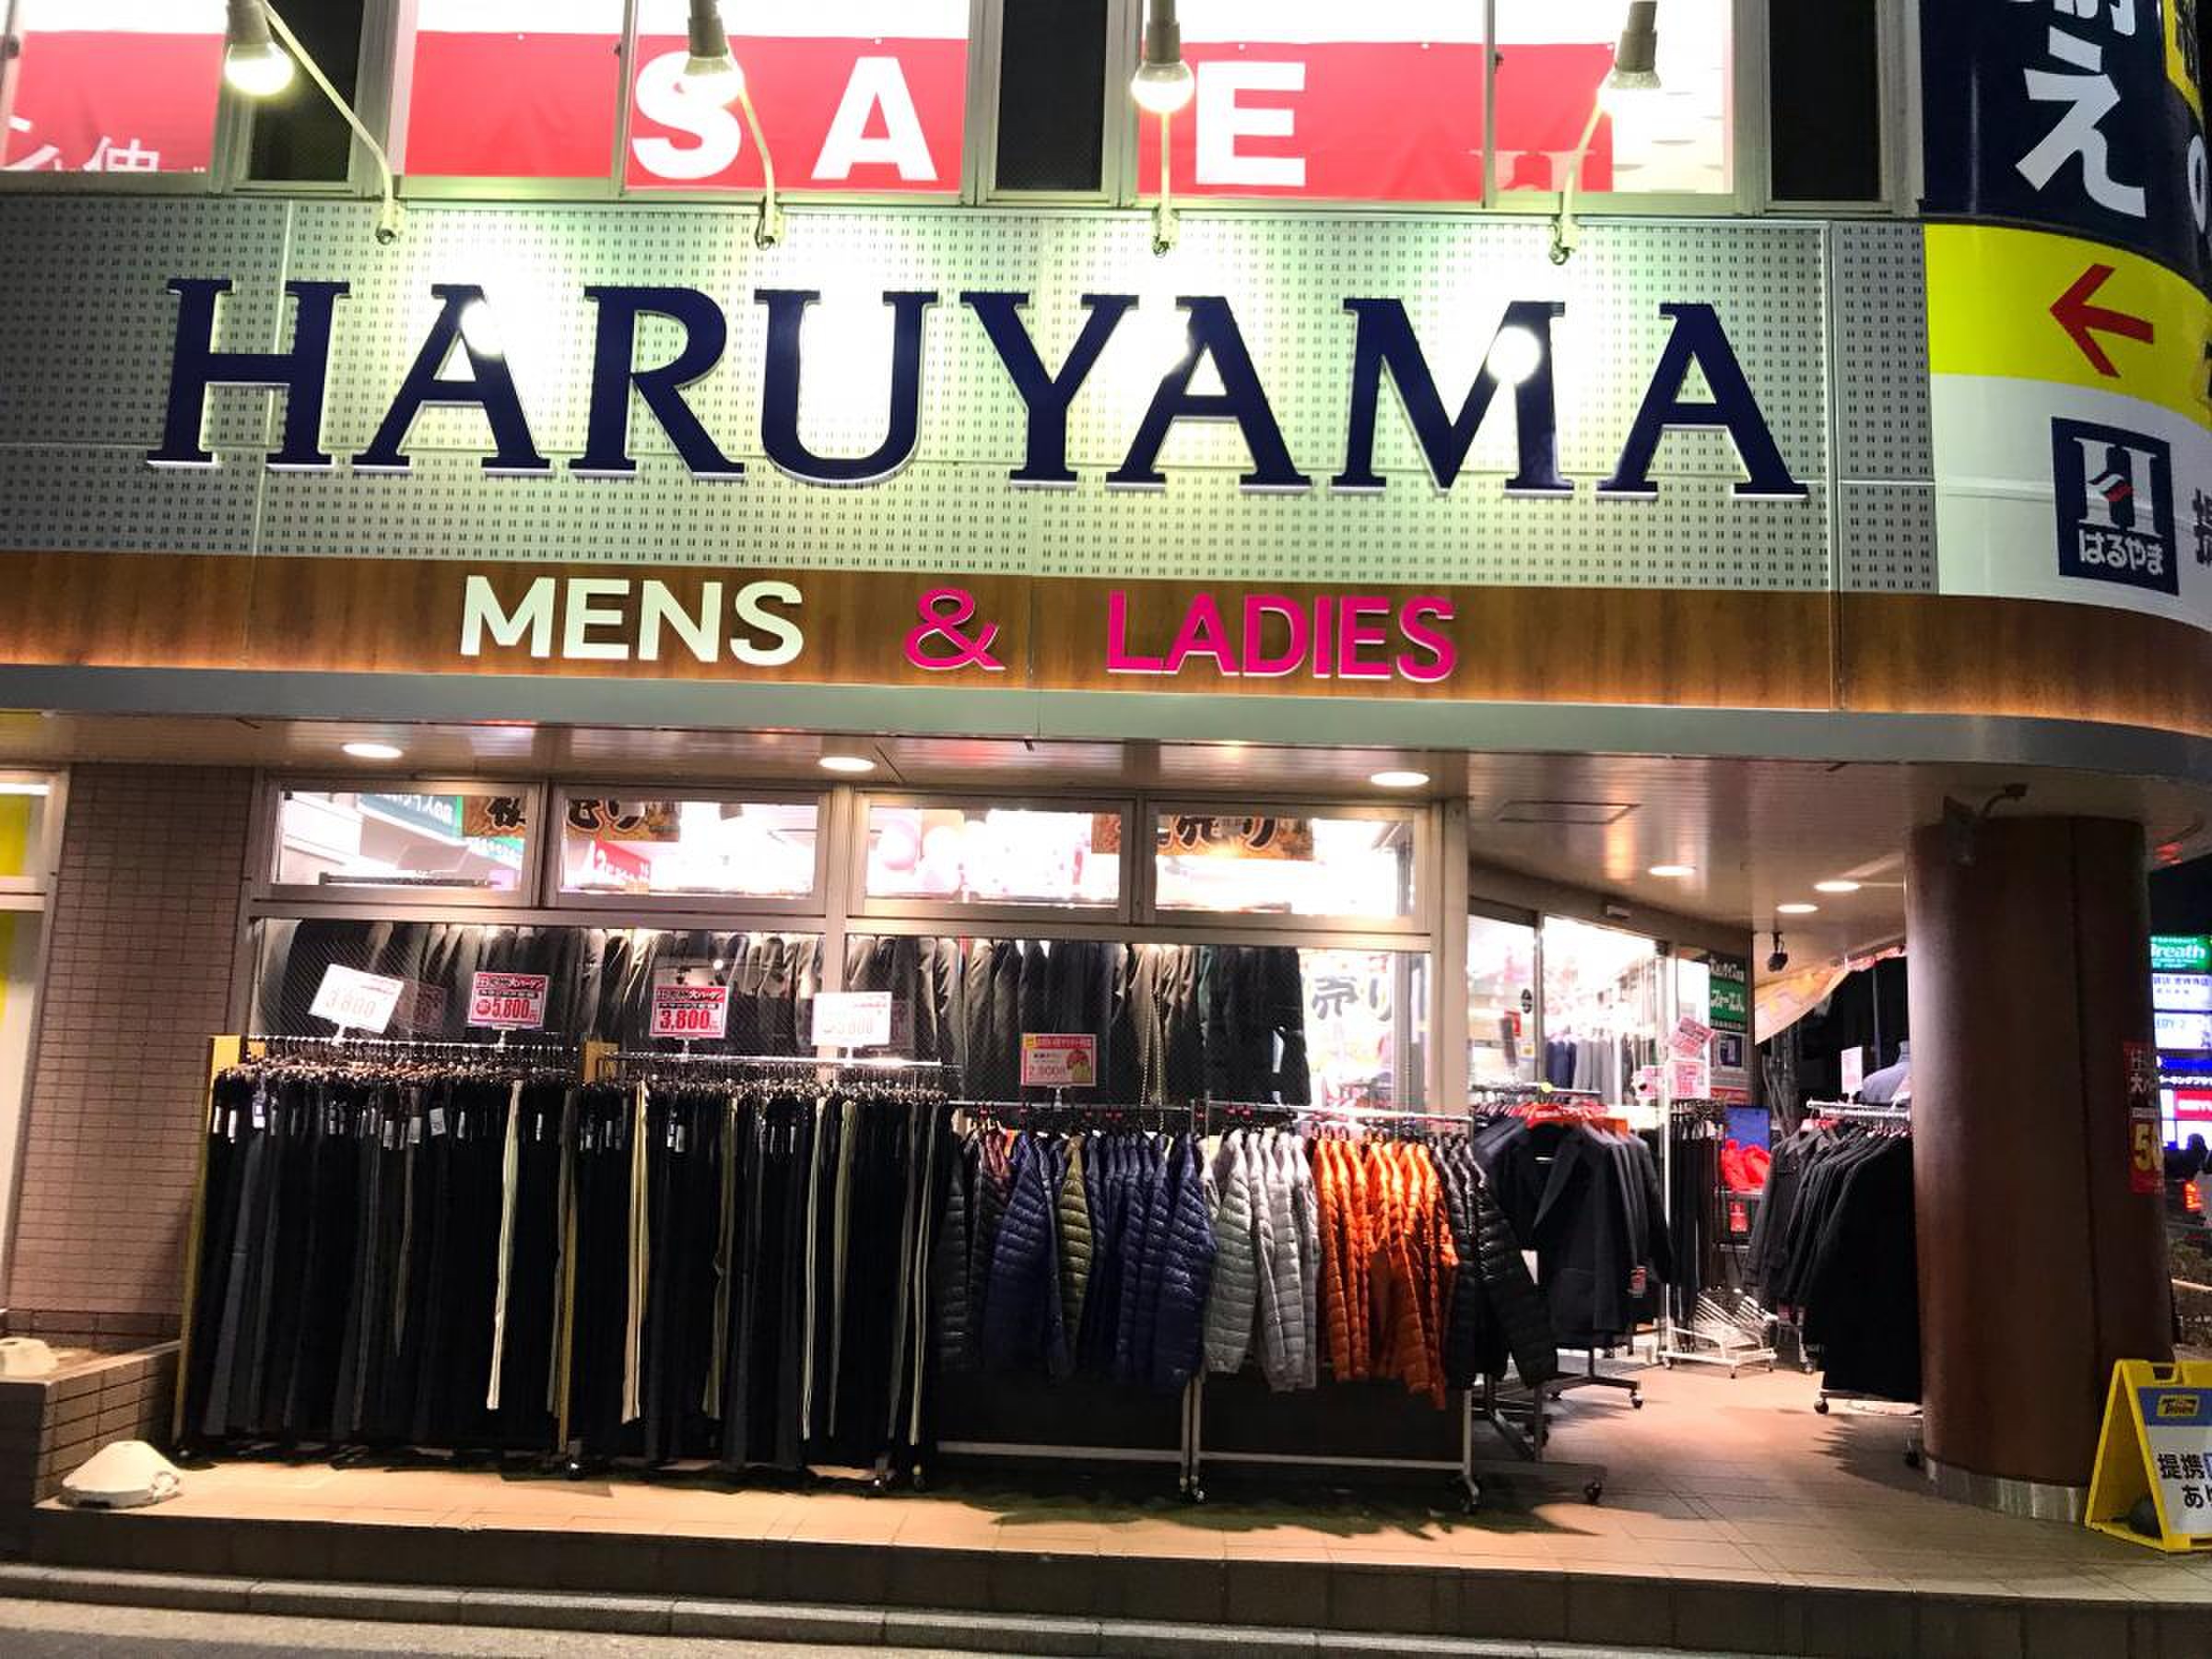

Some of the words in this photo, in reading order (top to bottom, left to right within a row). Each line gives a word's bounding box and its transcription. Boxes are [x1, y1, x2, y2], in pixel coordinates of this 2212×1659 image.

[147, 277, 1809, 503] HARUYAMA
[2078, 528, 2164, 576] はるやま
[460, 574, 805, 666] MENS
[903, 587, 1006, 670] &
[1106, 590, 1458, 683] LADIES
